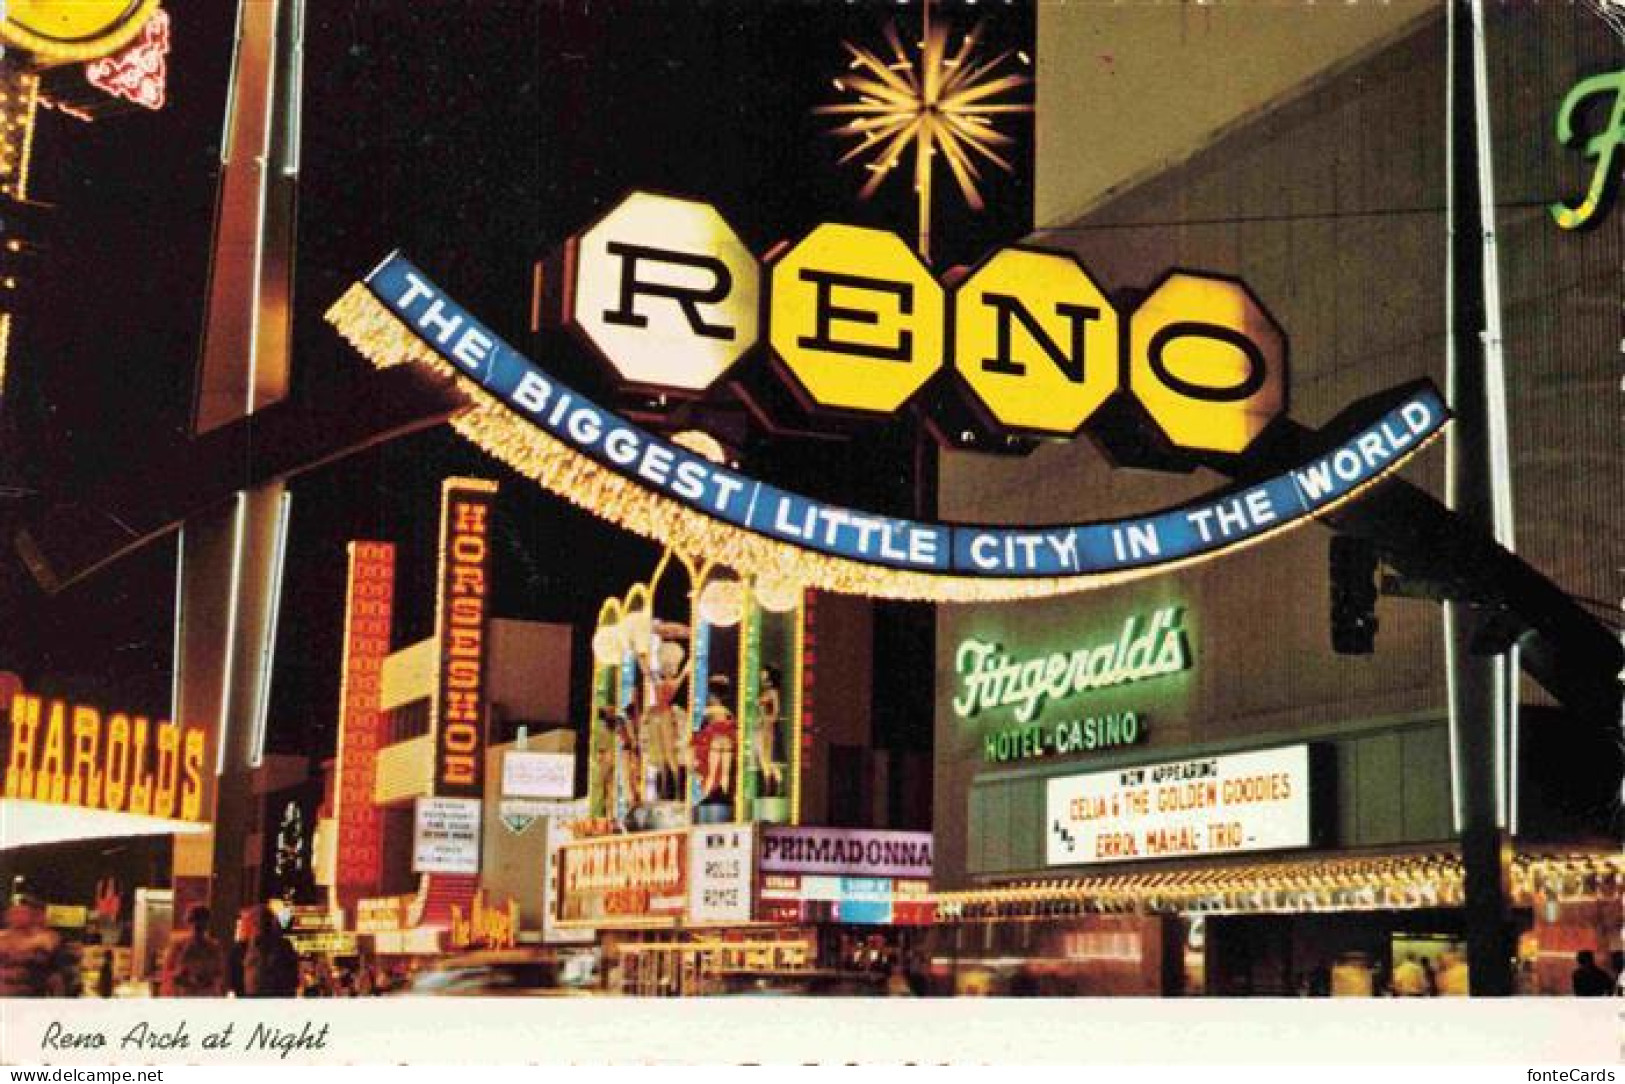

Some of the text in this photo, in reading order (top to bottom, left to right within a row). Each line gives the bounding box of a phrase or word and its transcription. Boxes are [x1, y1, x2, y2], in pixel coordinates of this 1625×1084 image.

[603, 241, 1266, 402] RENO
[397, 272, 1431, 569] THE BIGGEST LITTLE CITY IN THE WORLD
[953, 607, 1184, 722] Fitzgerald's
[6, 694, 205, 821] HAROLDS
[1121, 759, 1217, 786] NOW APPEARING
[1124, 789, 1149, 815] THE
[1158, 781, 1217, 812] GOLDEN
[1222, 773, 1291, 804] GOODIES
[763, 835, 933, 867] PRIMADONNA
[1096, 831, 1138, 858] ERROL
[1207, 821, 1242, 849] TRIO
